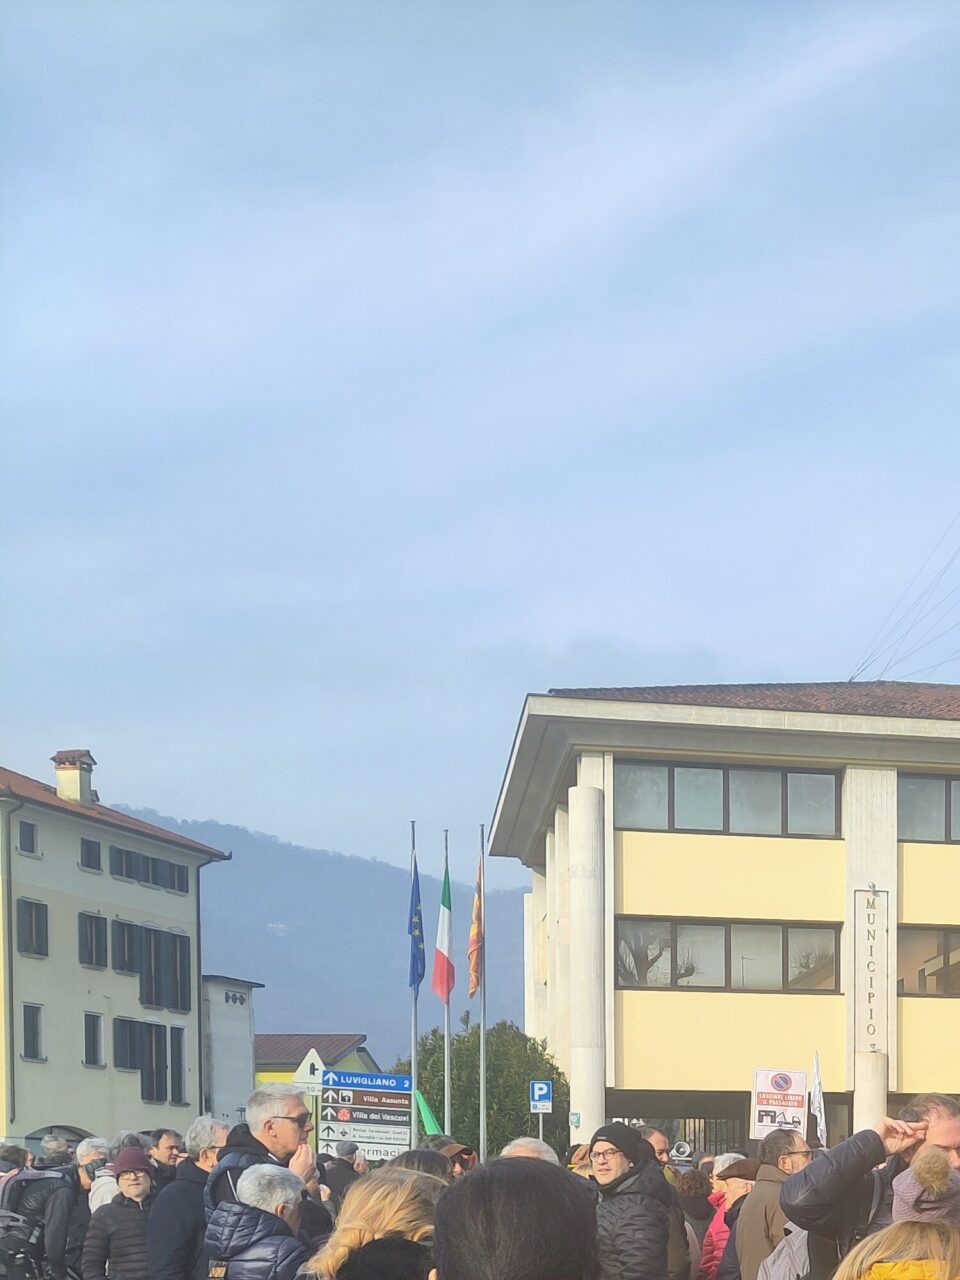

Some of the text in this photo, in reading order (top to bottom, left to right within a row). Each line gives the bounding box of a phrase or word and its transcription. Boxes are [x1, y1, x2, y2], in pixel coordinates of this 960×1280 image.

[866, 897, 876, 1036] MUNICIPIO
[340, 1075, 410, 1088] LUVIGLIANO 2
[533, 1083, 548, 1101] P
[363, 1095, 409, 1105] Villa Assunta
[352, 1111, 368, 1120] Villa
[381, 1113, 409, 1122] Vescovi
